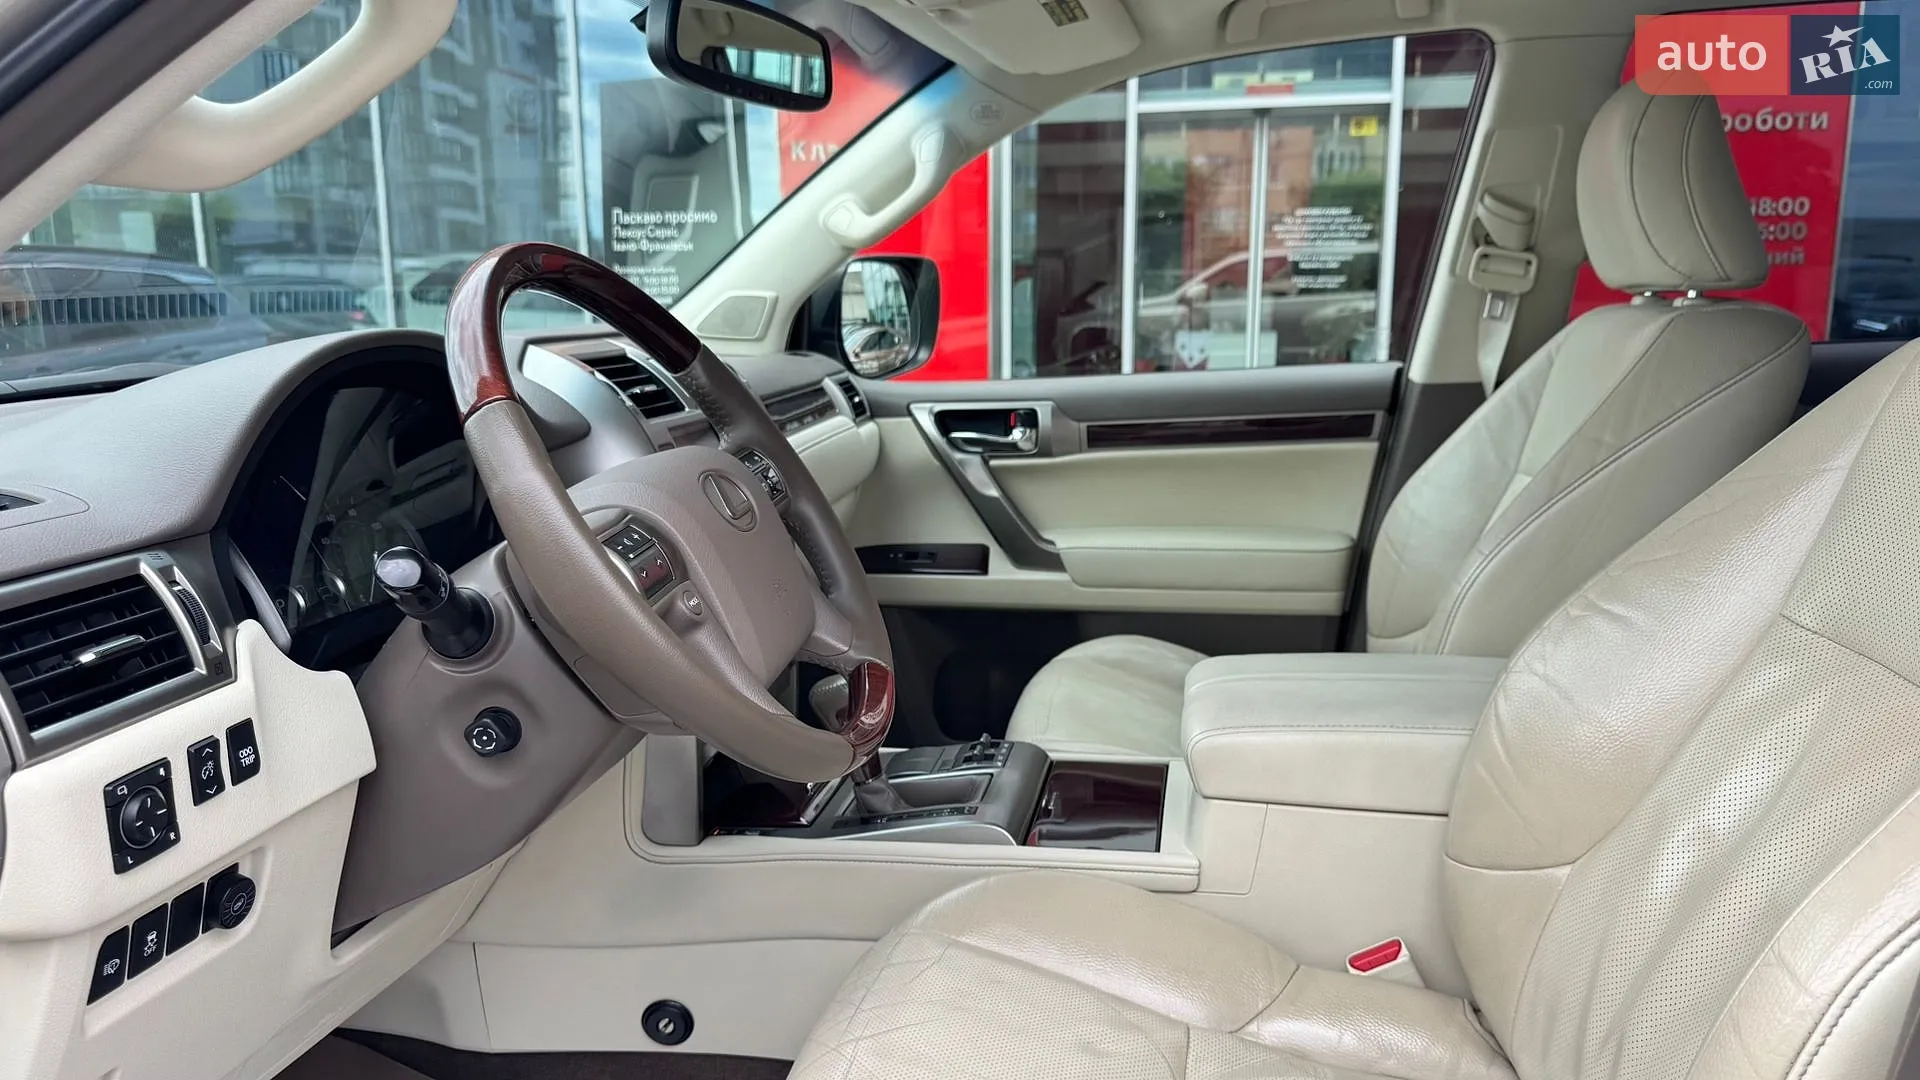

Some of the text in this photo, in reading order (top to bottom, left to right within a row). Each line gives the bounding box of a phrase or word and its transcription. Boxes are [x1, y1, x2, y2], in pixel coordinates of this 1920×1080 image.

[612, 207, 718, 225] Ласкаво просимо
[1759, 222, 1808, 241] 5:00
[239, 746, 254, 758] ODO
[240, 754, 256, 767] TRIP
